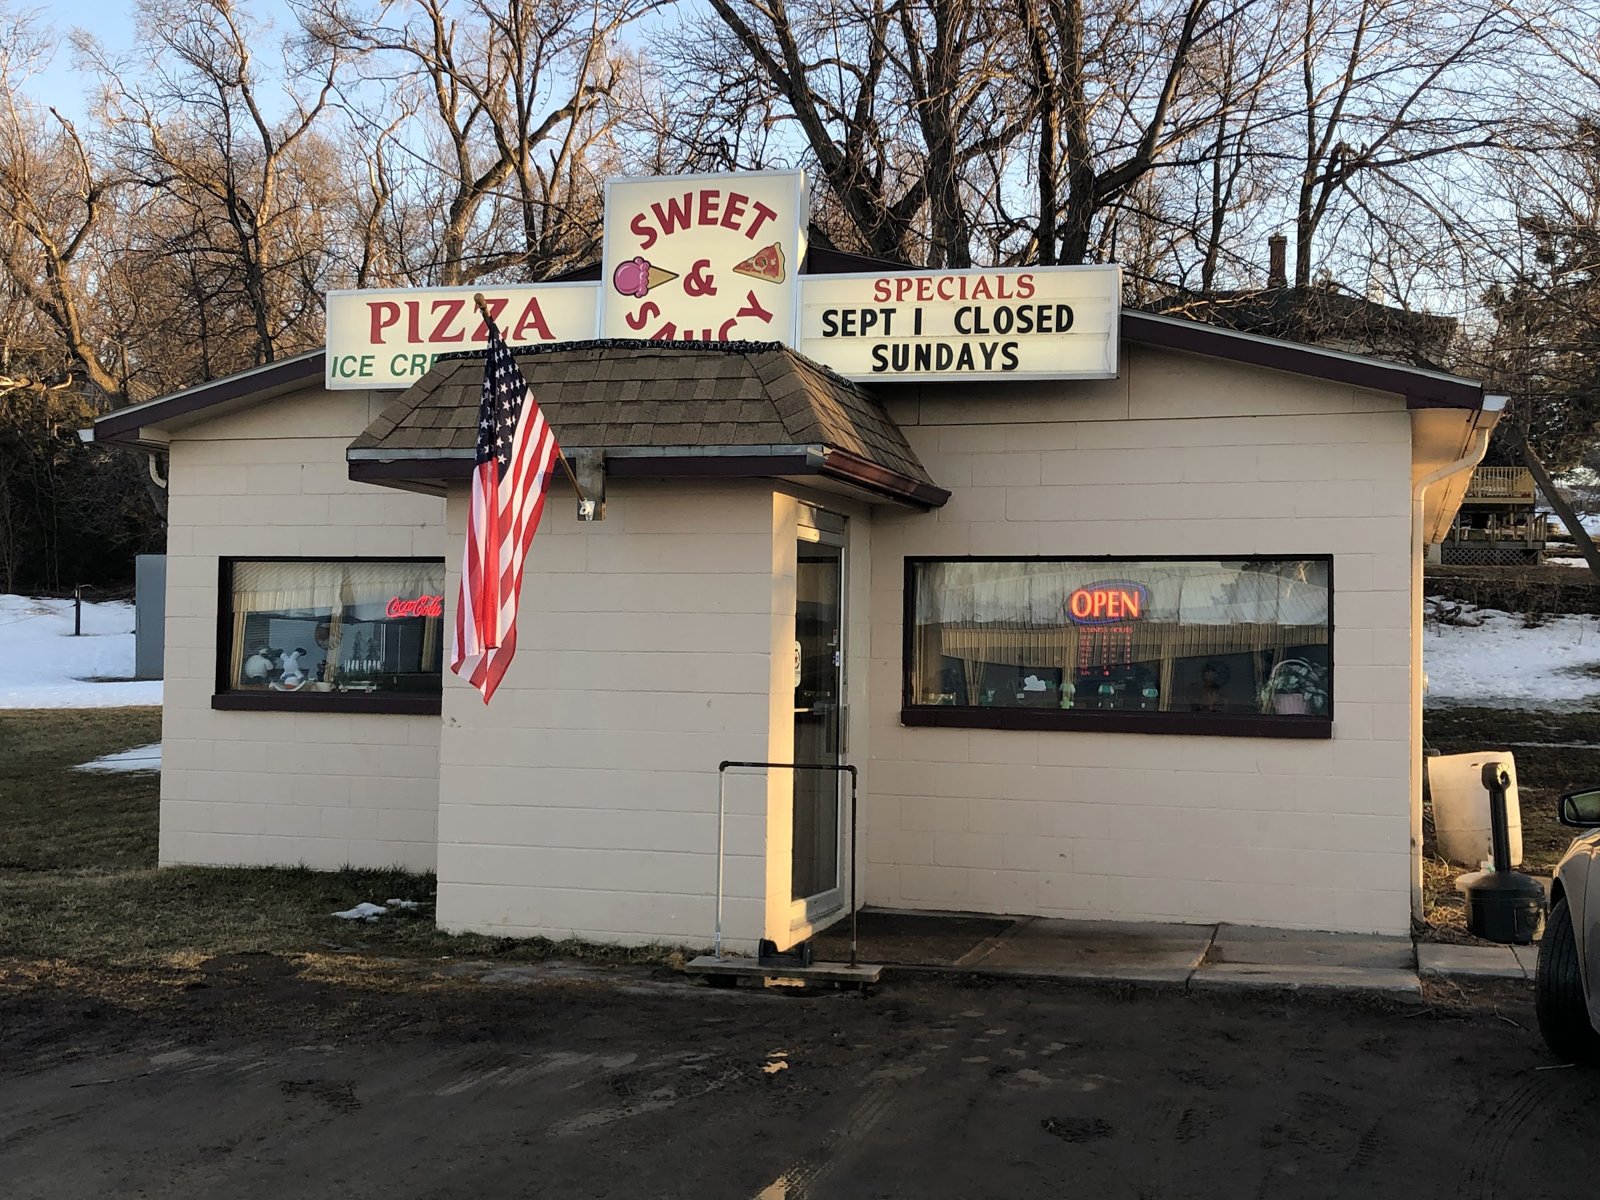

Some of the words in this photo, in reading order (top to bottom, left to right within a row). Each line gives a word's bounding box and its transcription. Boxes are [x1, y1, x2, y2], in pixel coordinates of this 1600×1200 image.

[630, 189, 777, 250] SWEET
[683, 259, 717, 297] &
[873, 274, 1036, 302] SPECIALS
[366, 296, 556, 344] PIZZA
[822, 308, 897, 337] SEPT
[953, 304, 1075, 334] CLOSED
[331, 355, 375, 378] ICE
[871, 341, 1020, 372] SUNDAYS
[1070, 590, 1140, 618] OPEN
